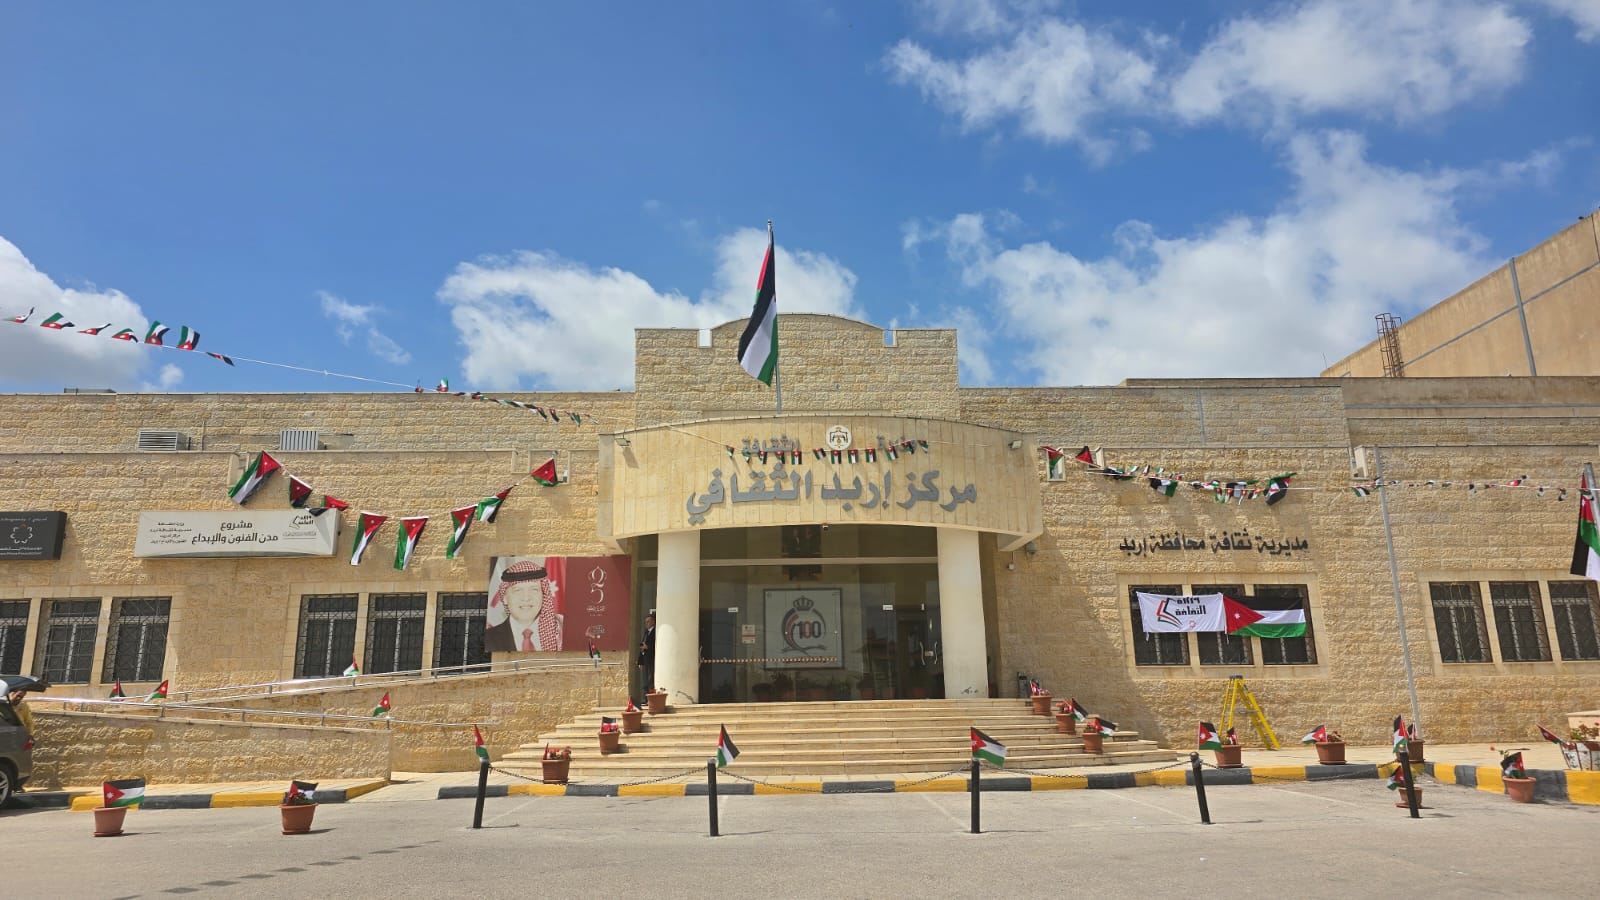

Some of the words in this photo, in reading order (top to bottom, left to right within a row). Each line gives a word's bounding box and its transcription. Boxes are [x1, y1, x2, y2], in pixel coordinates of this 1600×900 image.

[686, 462, 812, 525] الثقافي
[820, 470, 892, 511] إربد
[897, 470, 977, 512] مركز
[220, 520, 253, 531] مشروع
[191, 533, 227, 545] والإبداع
[228, 532, 258, 544] الفنون
[258, 533, 279, 543] مدن
[1119, 537, 1147, 557] إربد
[1150, 531, 1205, 553] محافظة
[1209, 528, 1252, 553] ثقافة
[1255, 535, 1308, 556] مديرية
[1175, 604, 1207, 616] الثقافة
[797, 620, 821, 639] 100
